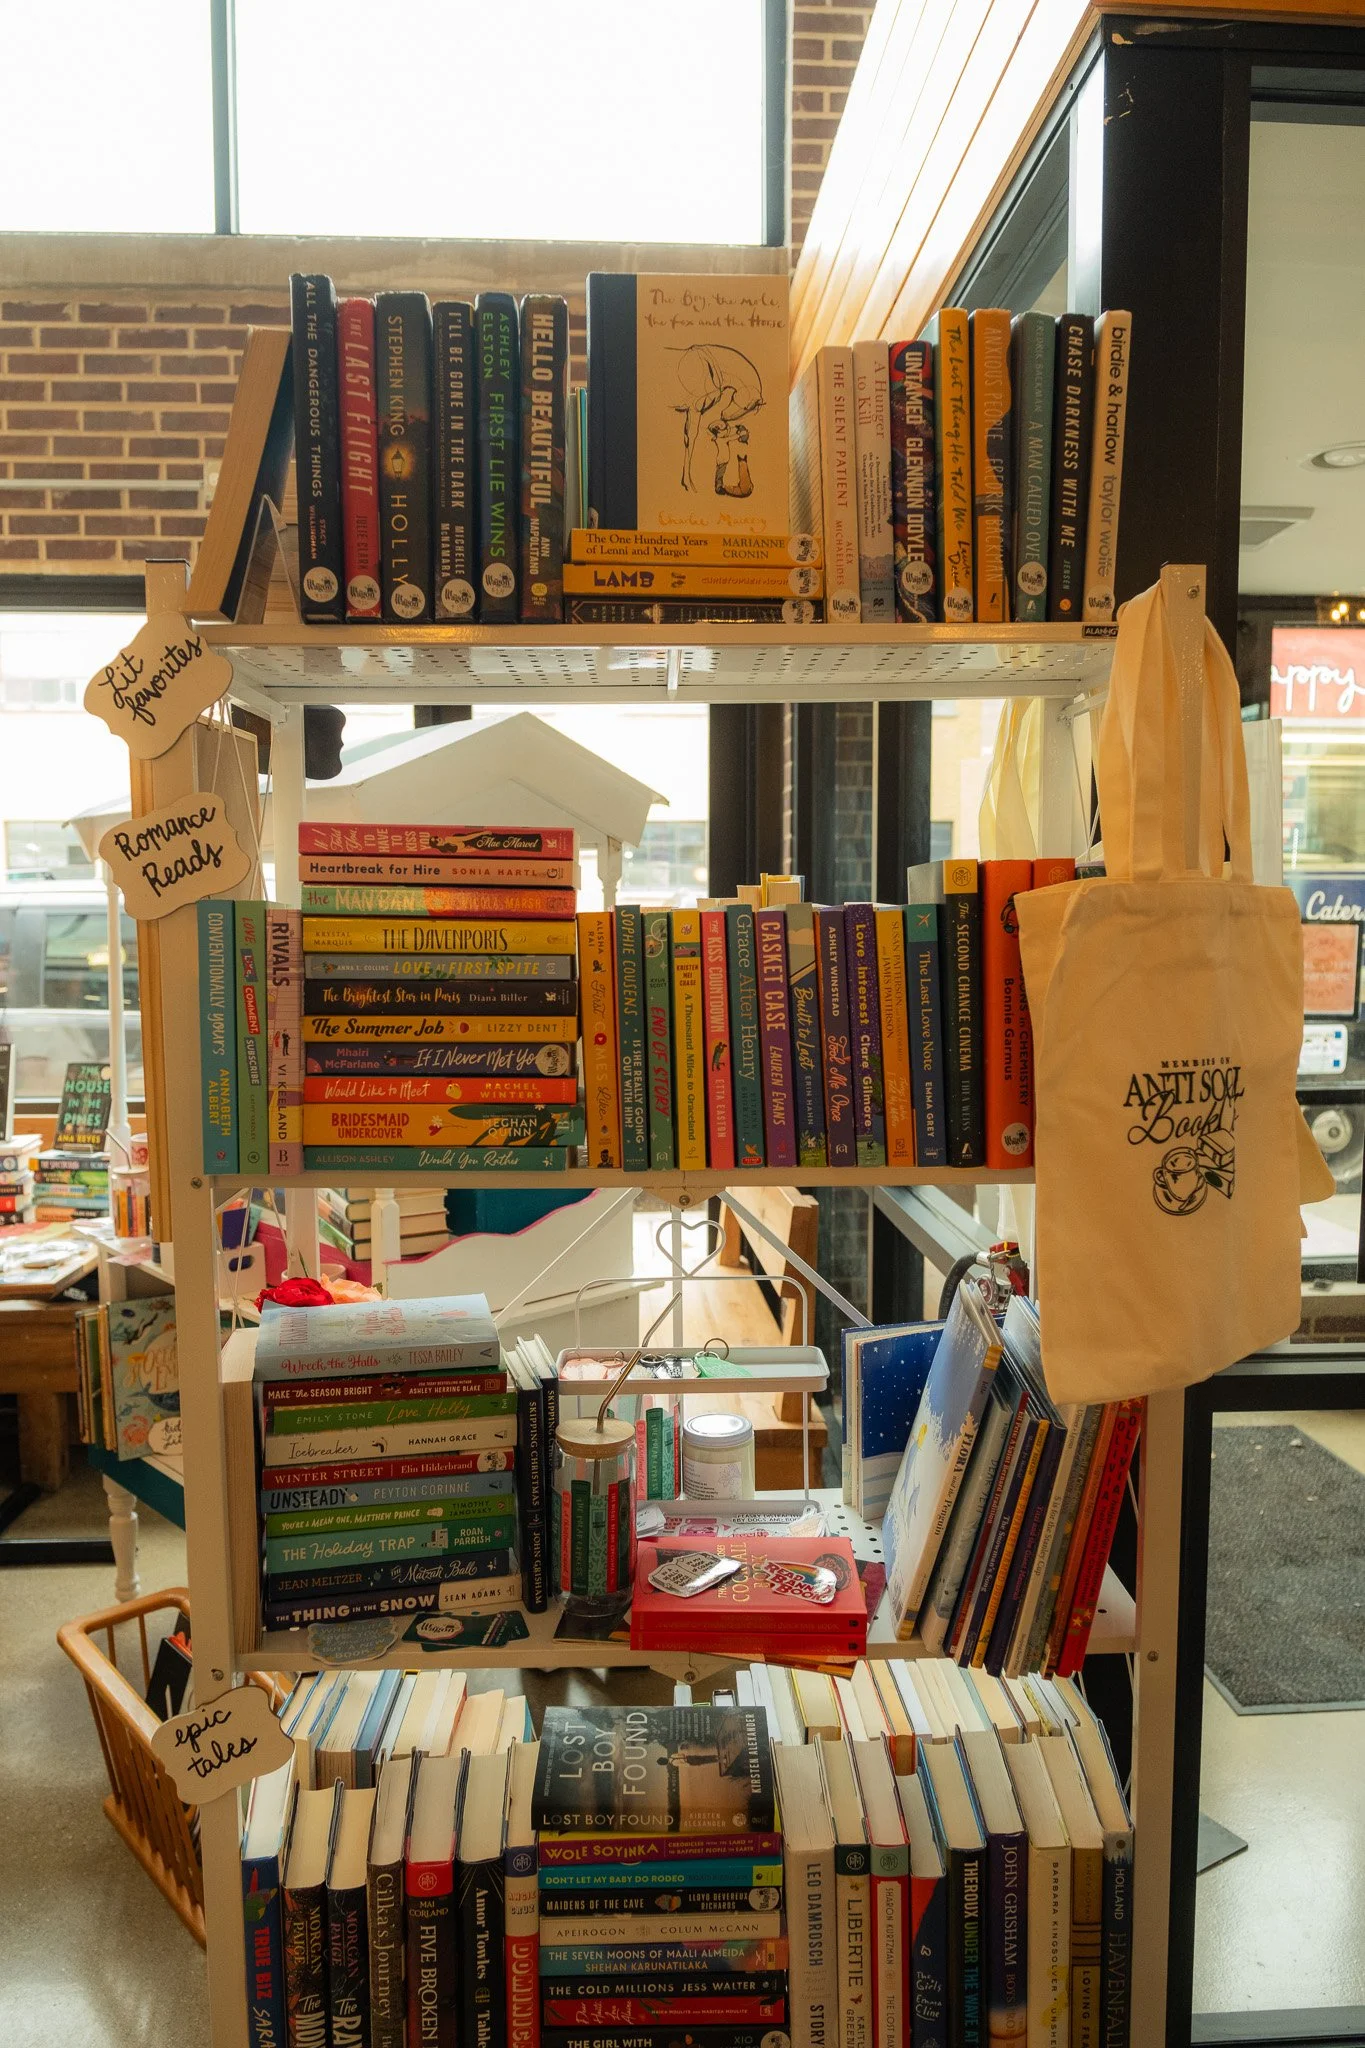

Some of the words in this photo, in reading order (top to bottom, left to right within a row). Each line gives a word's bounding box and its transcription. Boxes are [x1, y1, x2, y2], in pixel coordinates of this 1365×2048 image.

[306, 282, 315, 306] ALL
[307, 313, 317, 340] THE
[449, 312, 462, 337] I'LL
[388, 316, 403, 388] STEPHEN
[449, 341, 462, 364] BE
[483, 313, 493, 379] ELSTON
[499, 313, 510, 379] ASHLEY
[532, 314, 553, 380] HELLO
[1067, 326, 1084, 377] CHASE
[1110, 327, 1126, 379] birdie
[345, 342, 370, 401] LAST
[450, 371, 463, 408] GONE
[834, 363, 844, 388] THE
[905, 352, 922, 424] UNTAMED
[308, 349, 320, 437] DANGEROUS
[390, 396, 404, 436] KING
[451, 414, 463, 431] IN
[489, 394, 504, 452] FIRST
[835, 396, 846, 442] SILENT
[1064, 386, 1081, 469] DARKNESS
[1105, 402, 1126, 465] harlow
[346, 412, 374, 495] FLIGHT
[451, 438, 463, 463] THE
[530, 391, 552, 509] BEAUTIFUL
[311, 445, 322, 497] THINGS
[451, 471, 464, 508] DARK
[489, 460, 504, 492] LIE
[836, 451, 848, 508] PATIENT
[907, 437, 924, 509] GLENNON
[1062, 478, 1078, 517] WITH
[391, 495, 408, 585] HOLLY
[490, 502, 505, 557] WINS
[586, 534, 606, 545] The
[609, 535, 631, 544] One
[634, 535, 680, 545] Hundred
[684, 537, 708, 546] Years
[722, 538, 785, 548] MARIANNE
[907, 514, 924, 561] DOYLE
[1061, 526, 1075, 547] ME
[586, 546, 596, 555] of
[601, 546, 628, 555] Lenni
[632, 547, 650, 556] and
[653, 547, 689, 557] Margot
[723, 549, 769, 559] CRONIN
[594, 571, 655, 587] LAMB
[99, 653, 143, 708] Lit
[125, 636, 203, 726] favorites
[114, 806, 216, 861] Romance
[142, 838, 223, 897] Reads
[310, 863, 384, 874] Heartbreak
[389, 864, 408, 874] for
[413, 865, 440, 875] Hire
[272, 922, 290, 987] RIVALS
[383, 928, 408, 949] THE
[413, 927, 508, 952] DAVENPORTS
[707, 937, 722, 963] KISS
[737, 914, 752, 968] Grace
[761, 922, 783, 983] CASKET
[856, 924, 865, 958] Love
[957, 923, 969, 971] SECOND
[208, 913, 225, 1009] CONVENTIONALLY
[394, 962, 432, 975] LOVE
[450, 962, 492, 975] FIRST
[496, 962, 539, 975] SPITE
[918, 951, 930, 976] The
[708, 967, 725, 1033] COUNTDOWN
[739, 974, 756, 1020] After
[765, 991, 785, 1032] CASE
[857, 965, 870, 1025] Interest
[919, 979, 930, 1004] Last
[958, 977, 971, 1023] CHANCE
[312, 1019, 340, 1036] The
[344, 1018, 413, 1037] Summer
[414, 1018, 444, 1036] Job
[921, 1007, 932, 1038] Love
[739, 1024, 757, 1081] Henry
[923, 1041, 934, 1071] Note
[959, 1027, 971, 1072] CINEMA
[65, 1081, 110, 1094] HOUSE
[208, 1080, 219, 1126] ALBERT
[219, 1069, 231, 1136] ANNABETH
[925, 1081, 933, 1110] EMMA
[331, 1113, 410, 1126] BRIDESMAID
[338, 1128, 403, 1138] UNDERCOVER
[926, 1112, 935, 1138] GREY
[268, 1389, 290, 1399] MAKE
[292, 1388, 309, 1398] the
[310, 1387, 340, 1397] SEASON
[343, 1386, 373, 1395] BRIGHT
[408, 1436, 447, 1445] HANNAH
[450, 1433, 477, 1442] GRACE
[953, 1436, 973, 1475] FLORA
[275, 1472, 328, 1484] WINTER
[333, 1467, 384, 1479] STREET
[271, 1488, 348, 1509] UNSTEADY
[283, 1548, 306, 1561] THE
[310, 1540, 374, 1560] Holiday
[379, 1537, 415, 1551] TRAP
[764, 1561, 805, 1582] READ
[292, 1604, 350, 1623] THING
[380, 1594, 435, 1612] SNOW
[175, 1709, 232, 1752] epic
[559, 1721, 587, 1779] LOST
[592, 1728, 617, 1772] BOY
[188, 1738, 257, 1777] tales
[623, 1712, 647, 1795] FOUND
[543, 1815, 581, 1825] LOST
[585, 1815, 617, 1825] BOY
[620, 1815, 674, 1826] FOUND
[545, 1847, 588, 1861] WOLE
[593, 1844, 659, 1858] SOYINKA
[1002, 1845, 1017, 1888] JOHN
[476, 1888, 489, 1927] Amor
[964, 1860, 979, 1918] THEROUX
[420, 1925, 436, 1962] FIVE
[556, 1927, 626, 1937] APEIROGON
[660, 1926, 702, 1934] COLUM
[709, 1924, 760, 1933] McCANN
[848, 1900, 863, 1987] LIBERTIE
[1004, 1892, 1018, 1966] GRISHAM
[476, 1930, 489, 1980] Towles
[549, 1952, 568, 1960] THE
[572, 1951, 603, 1959] SEVEN
[607, 1951, 645, 1959] MOONS
[650, 1950, 662, 1959] OF
[667, 1950, 698, 1958] MAALI
[701, 1949, 745, 1957] ALMEIDA
[585, 1963, 627, 1972] SHEHAN
[631, 1961, 708, 1971] KARUNATILAKA
[420, 1965, 439, 2040] BROKEN
[549, 1986, 572, 1995] THE
[578, 1985, 610, 1994] COLD
[615, 1983, 674, 1993] MILLIONS
[682, 1982, 707, 1992] JESS
[712, 1981, 756, 1991] WALTER
